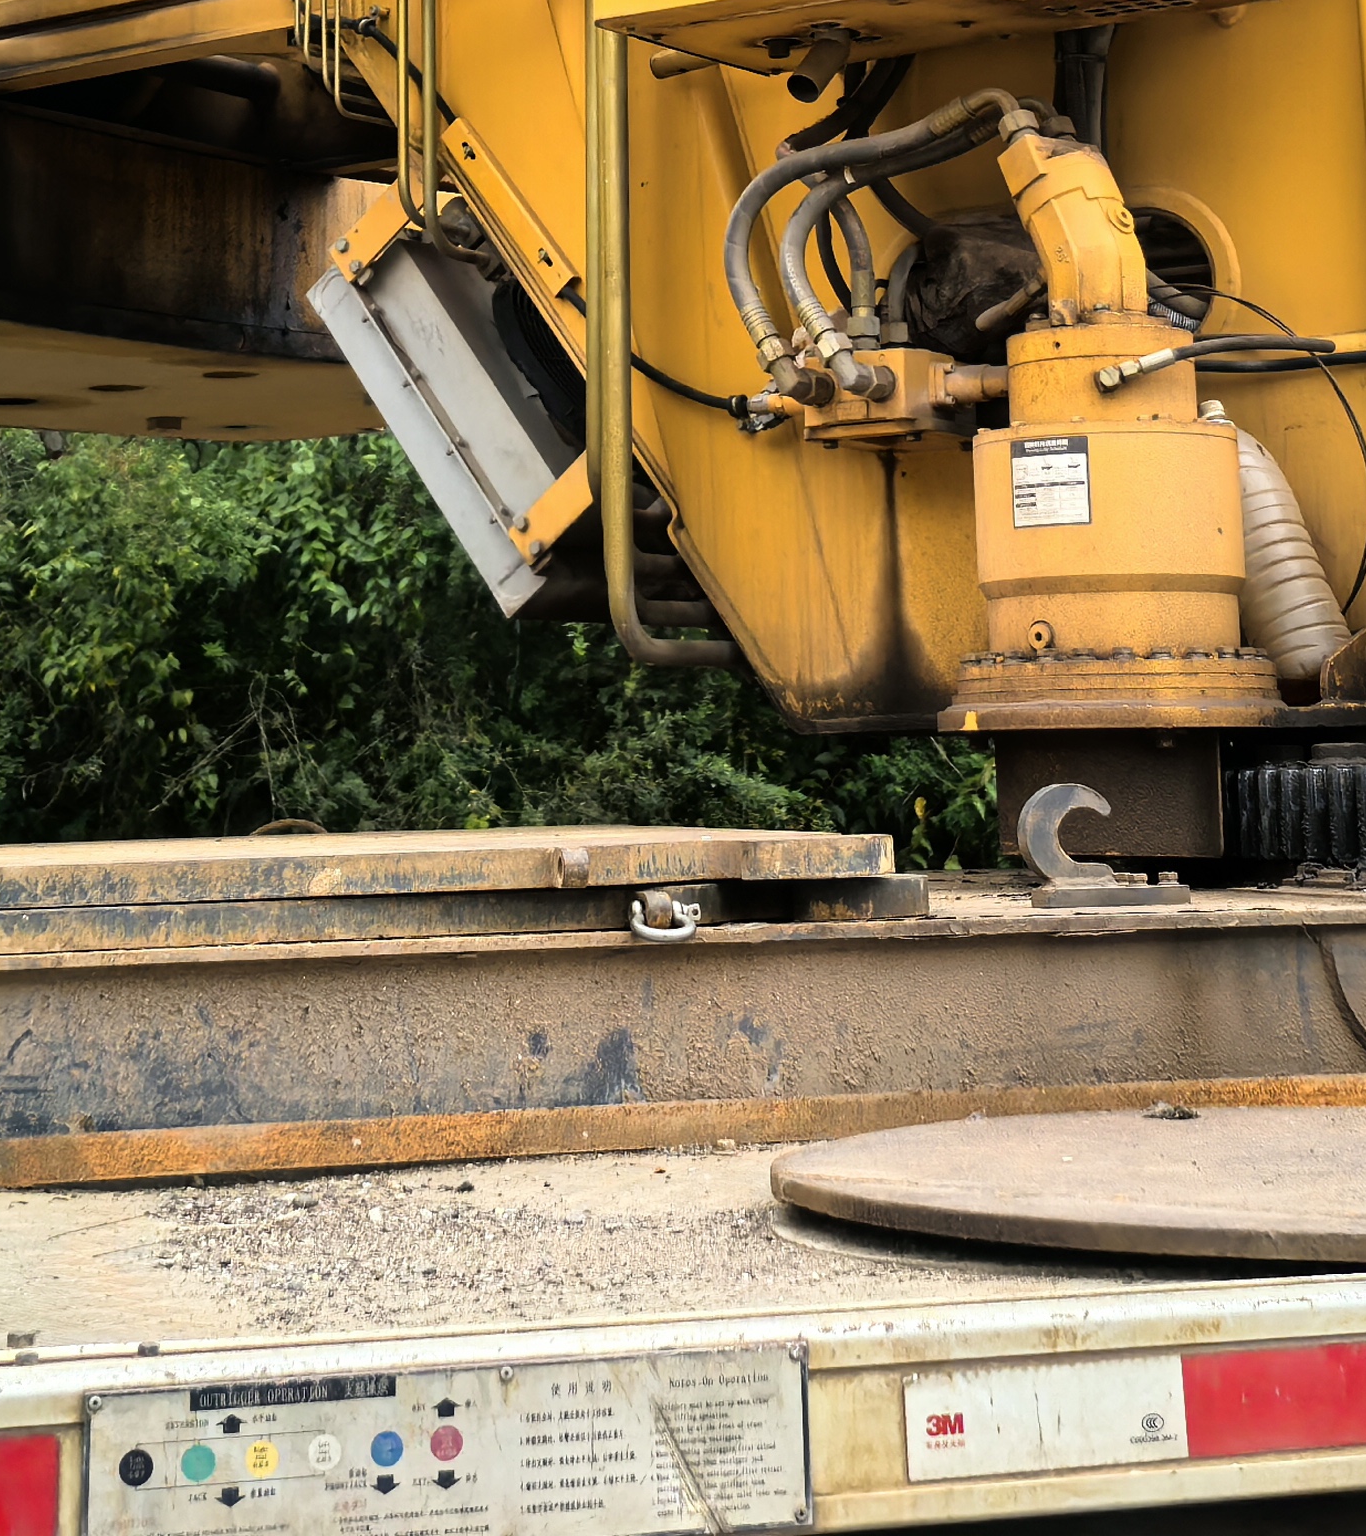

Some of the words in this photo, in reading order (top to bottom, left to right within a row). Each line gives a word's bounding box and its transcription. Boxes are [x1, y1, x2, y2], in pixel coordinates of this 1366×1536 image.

[199, 1387, 260, 1408] OUTRIGGER
[267, 1384, 328, 1403] OPERATION
[926, 1412, 964, 1436] 3M
